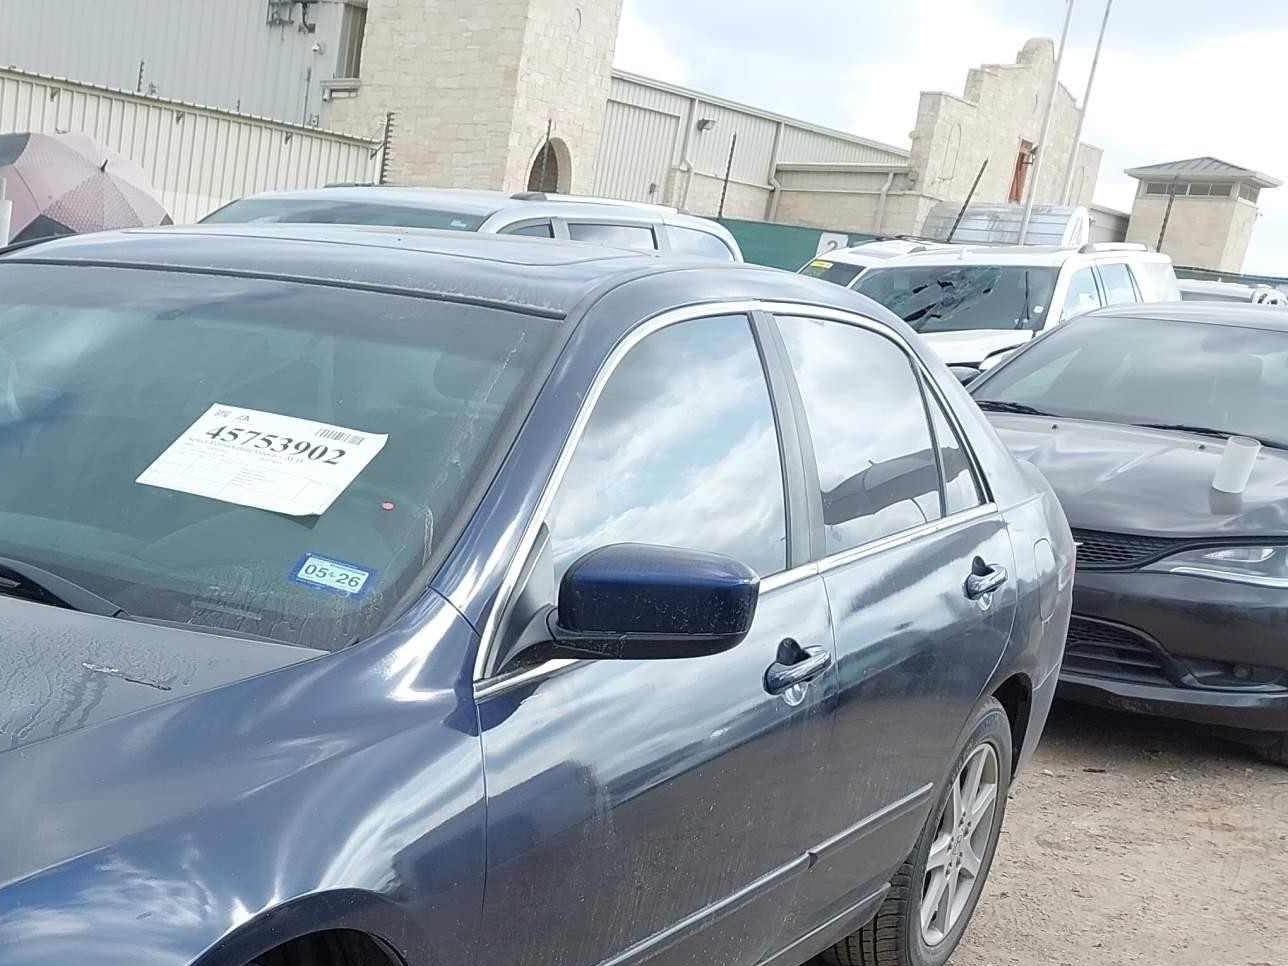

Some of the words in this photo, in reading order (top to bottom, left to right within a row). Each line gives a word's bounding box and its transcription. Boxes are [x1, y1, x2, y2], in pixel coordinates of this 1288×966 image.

[206, 425, 346, 465] 45753902
[304, 564, 329, 579] 05
[335, 573, 361, 588] 26
